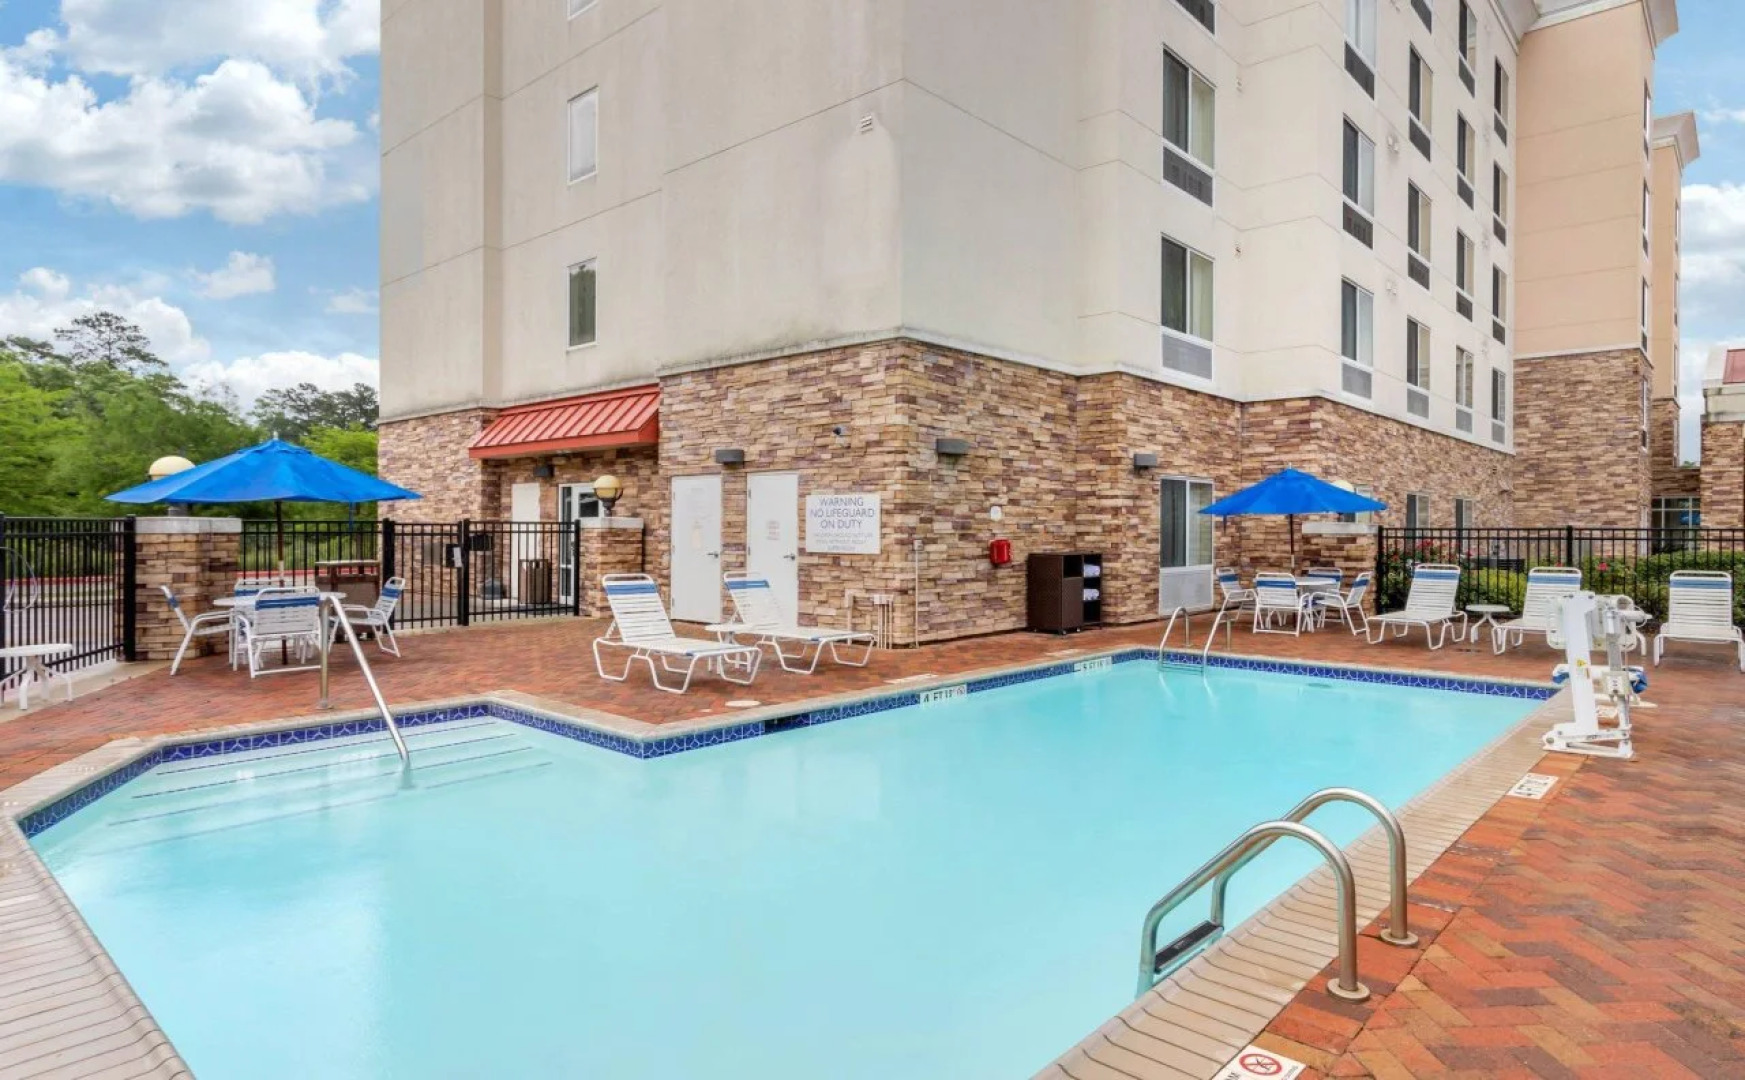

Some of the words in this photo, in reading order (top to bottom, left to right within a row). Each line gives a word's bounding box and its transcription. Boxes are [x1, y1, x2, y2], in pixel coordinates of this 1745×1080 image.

[819, 496, 864, 507] WARNING
[809, 508, 824, 518] NO
[825, 508, 875, 518] LIFEGUARD
[820, 519, 835, 529] ON
[838, 519, 862, 529] DUTY
